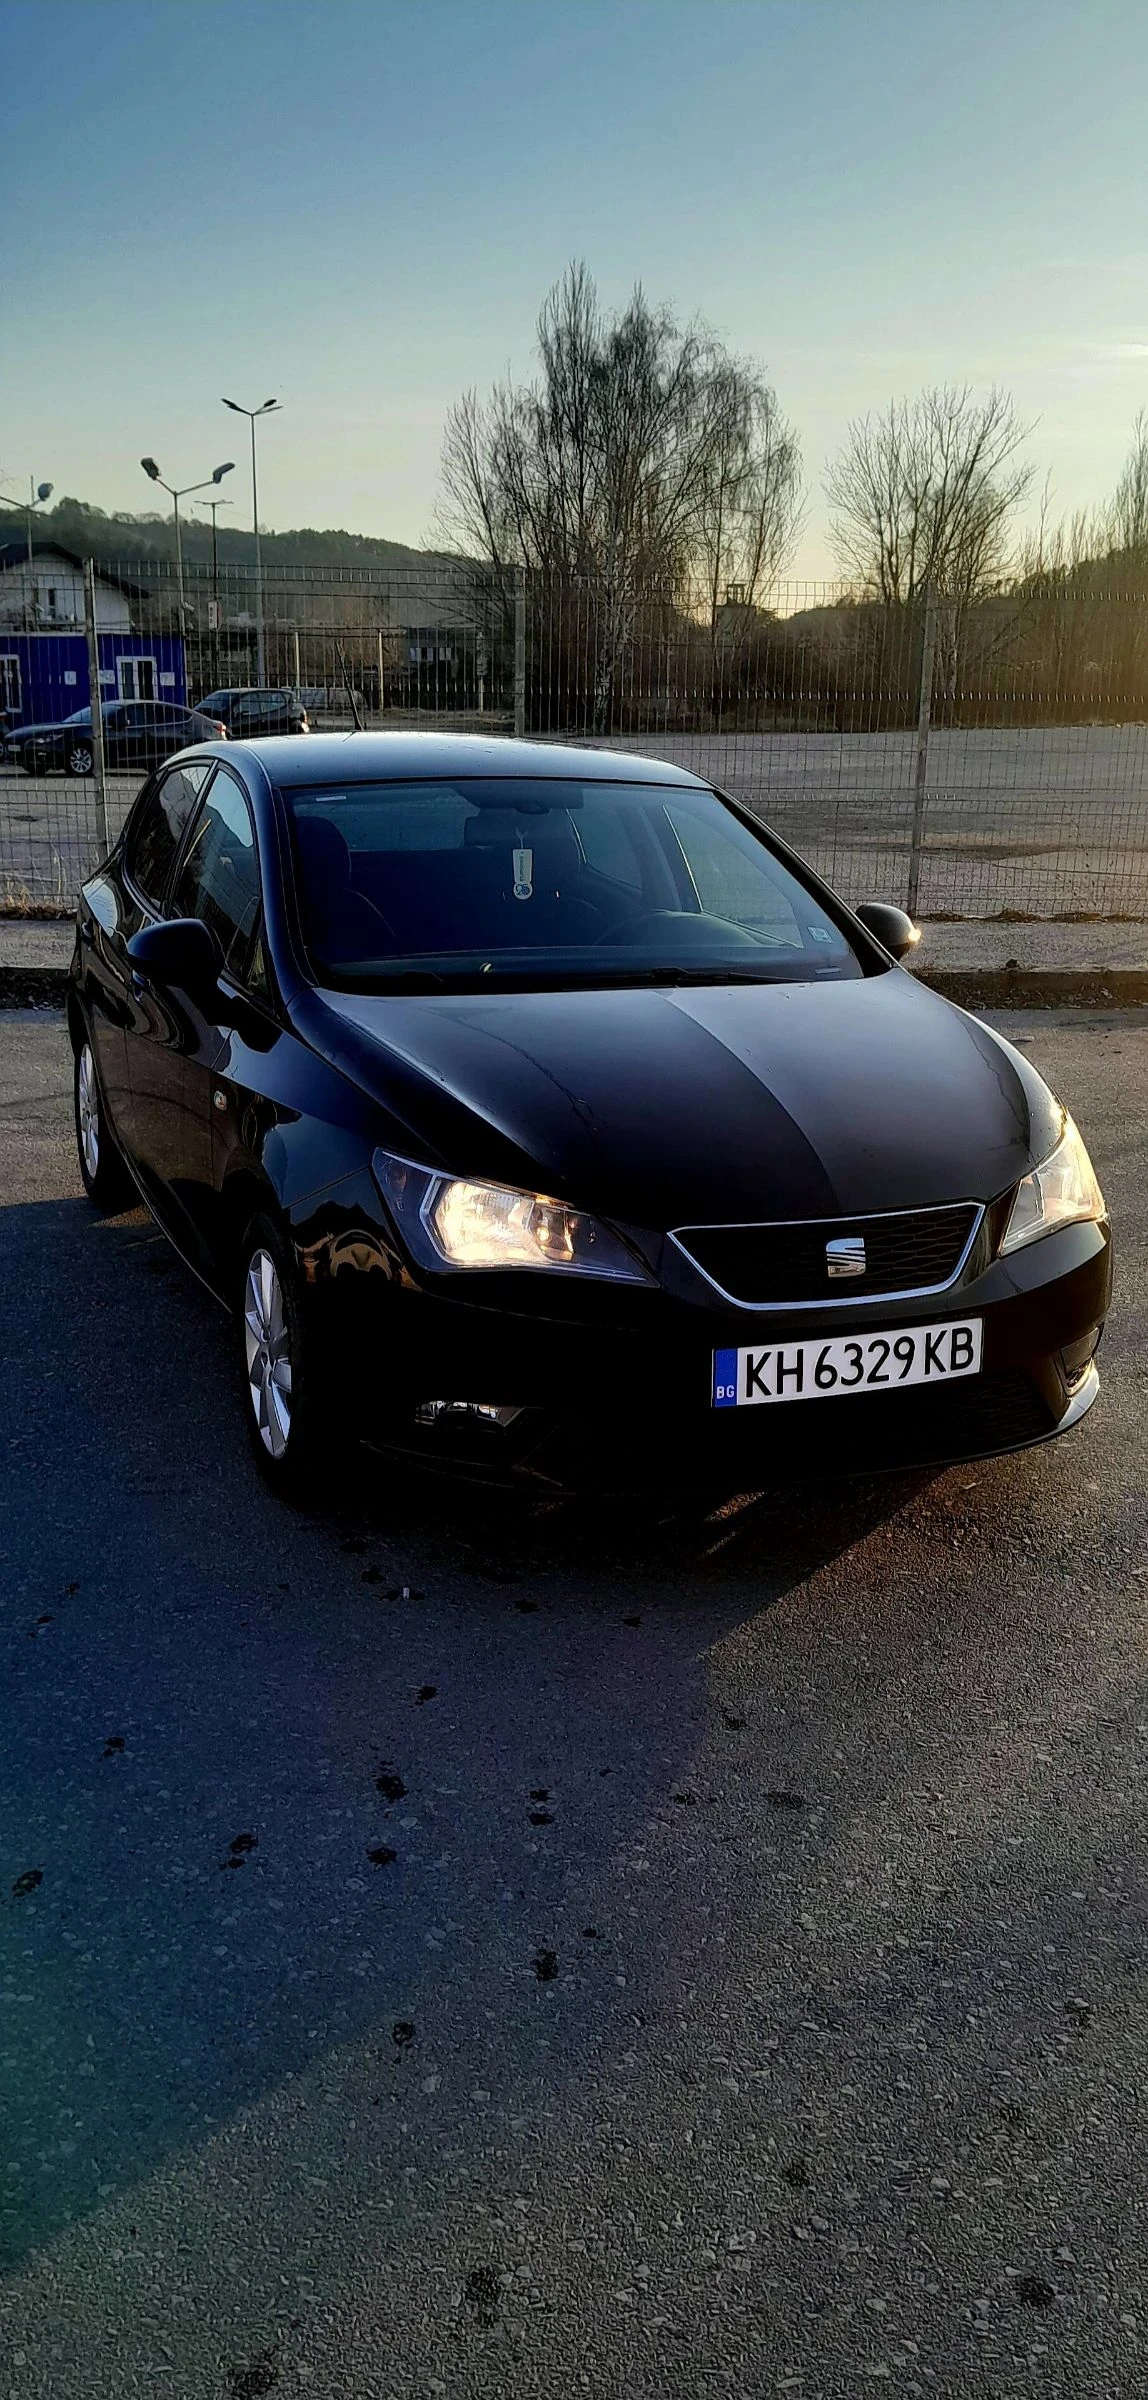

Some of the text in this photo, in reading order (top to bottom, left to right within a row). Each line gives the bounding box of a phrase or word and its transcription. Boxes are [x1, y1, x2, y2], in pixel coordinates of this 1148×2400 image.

[746, 1327, 974, 1398] KH 6329 KB
[716, 1385, 735, 1399] BG
